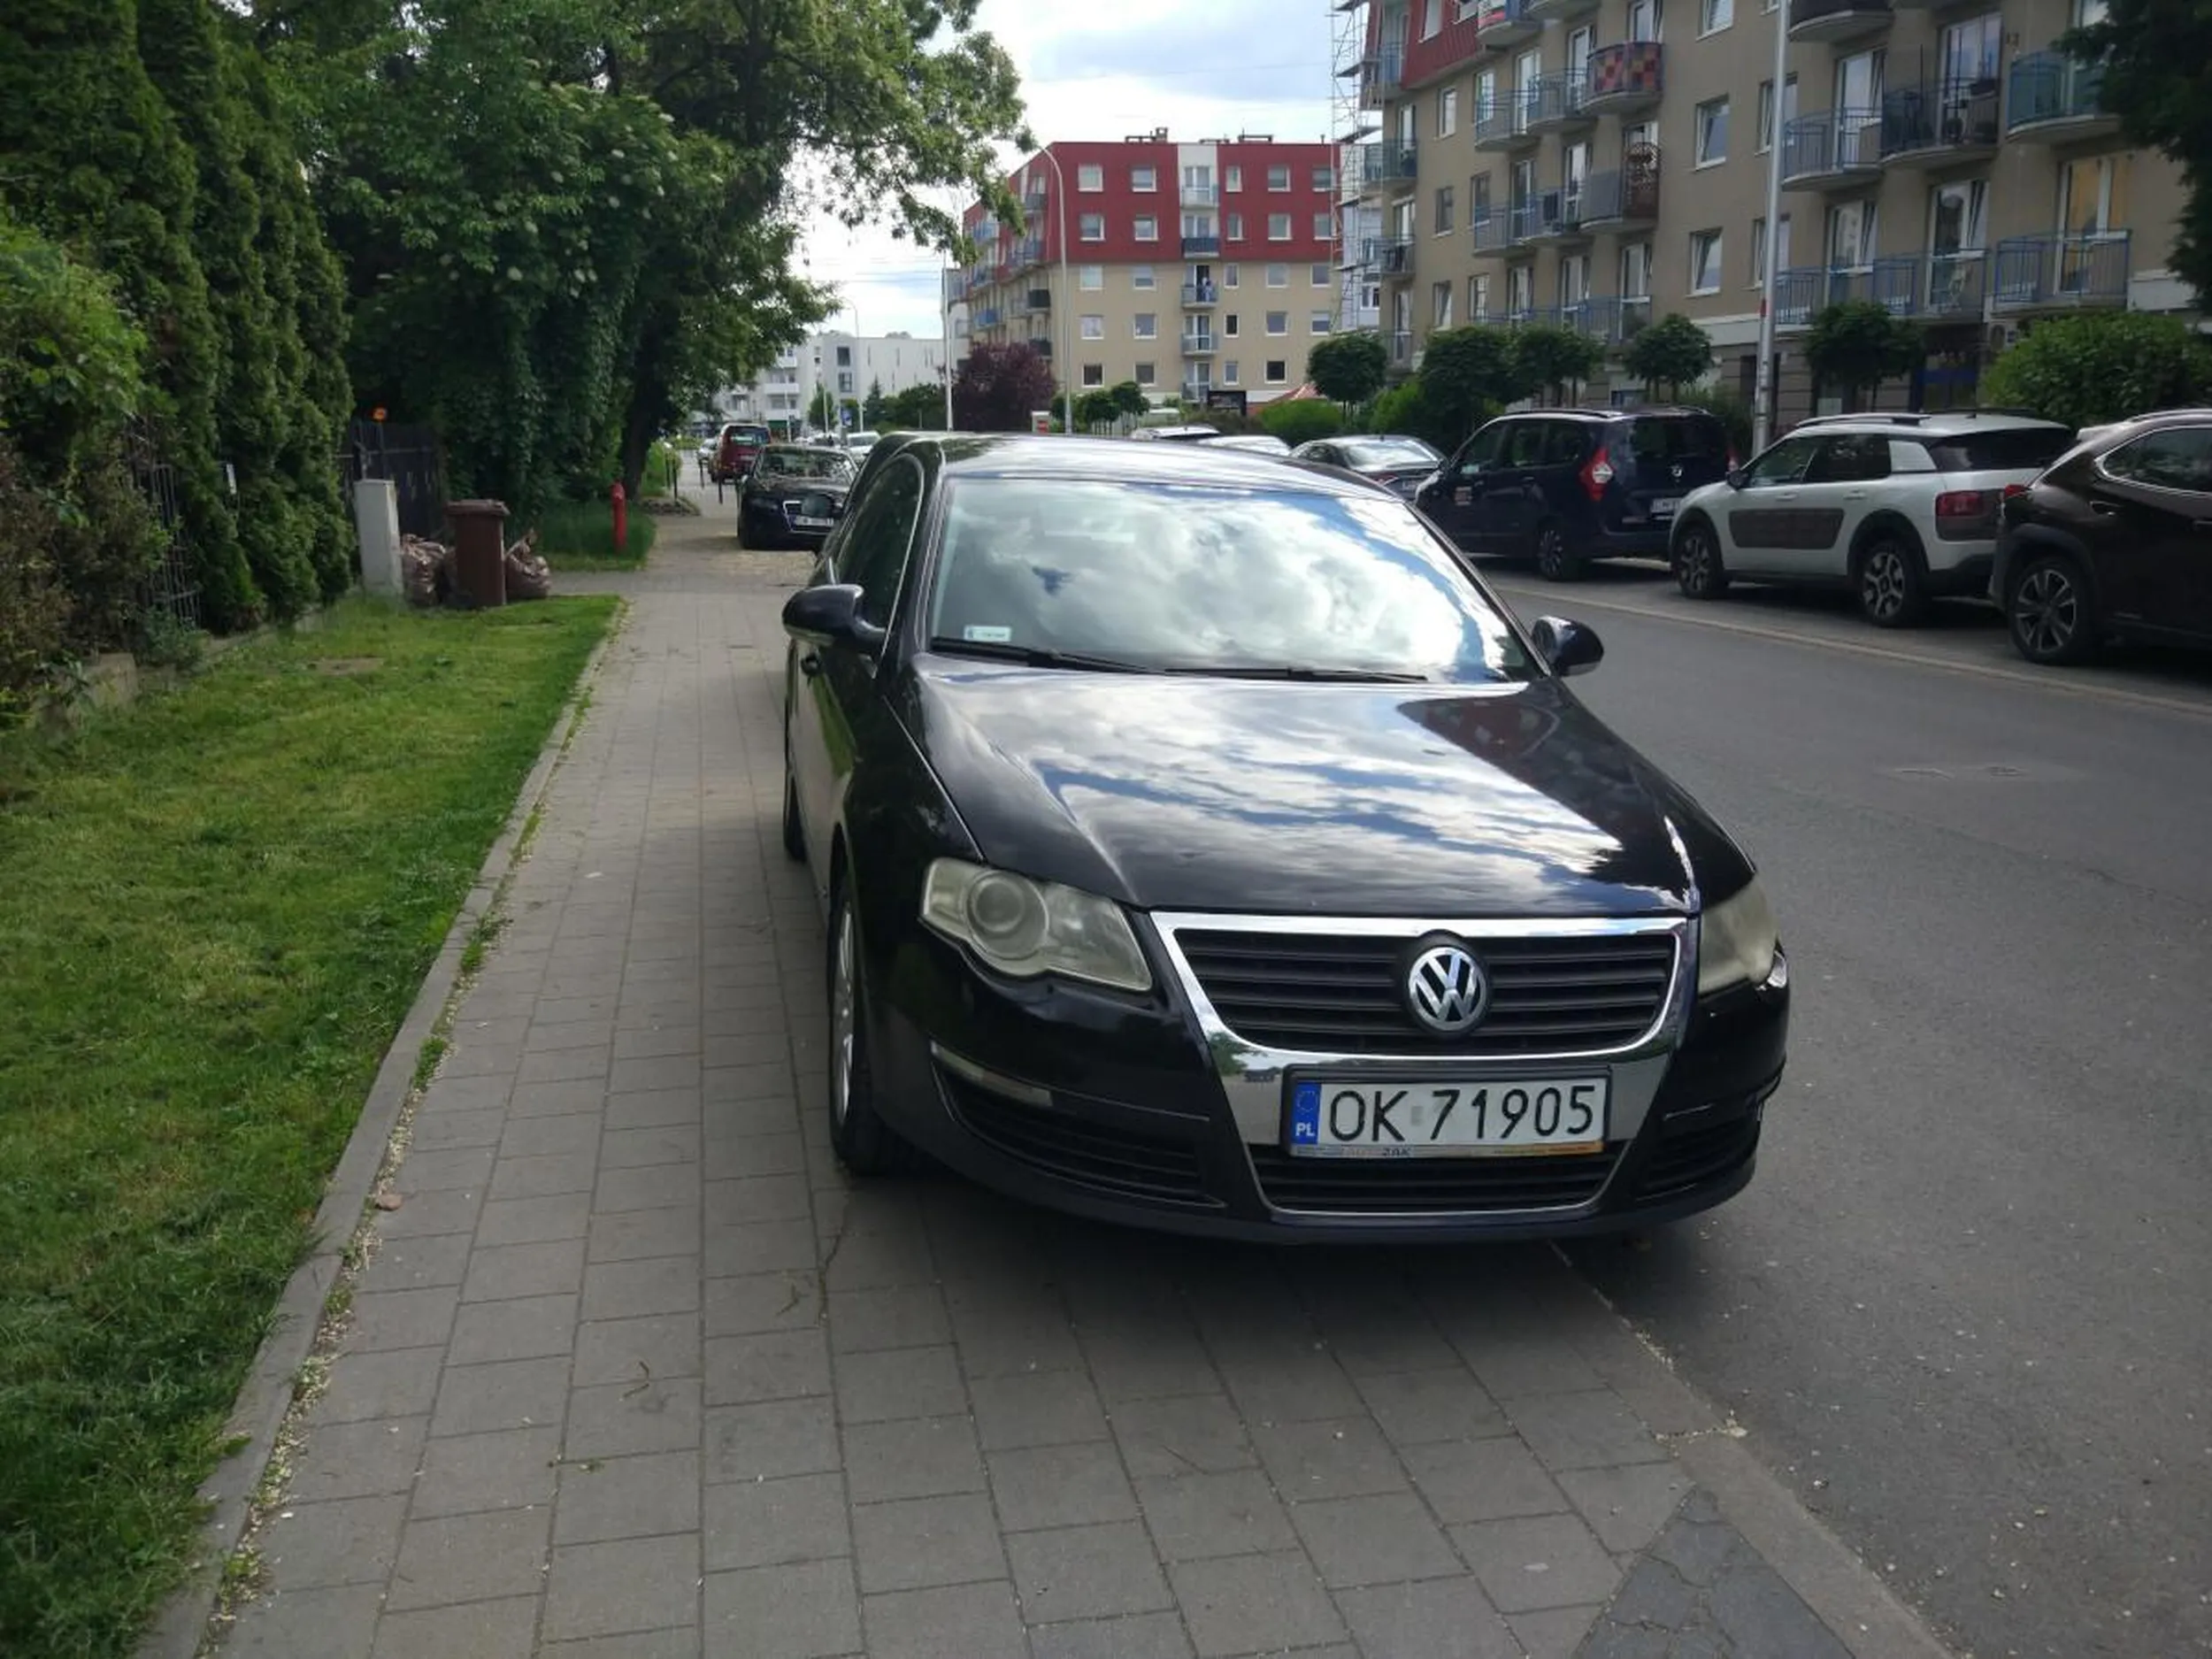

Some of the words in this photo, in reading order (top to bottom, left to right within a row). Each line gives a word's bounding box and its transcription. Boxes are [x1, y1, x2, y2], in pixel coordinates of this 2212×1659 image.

[1295, 1123, 1316, 1137] PL
[1330, 1090, 1408, 1141] OK
[1430, 1086, 1595, 1141] 71905
